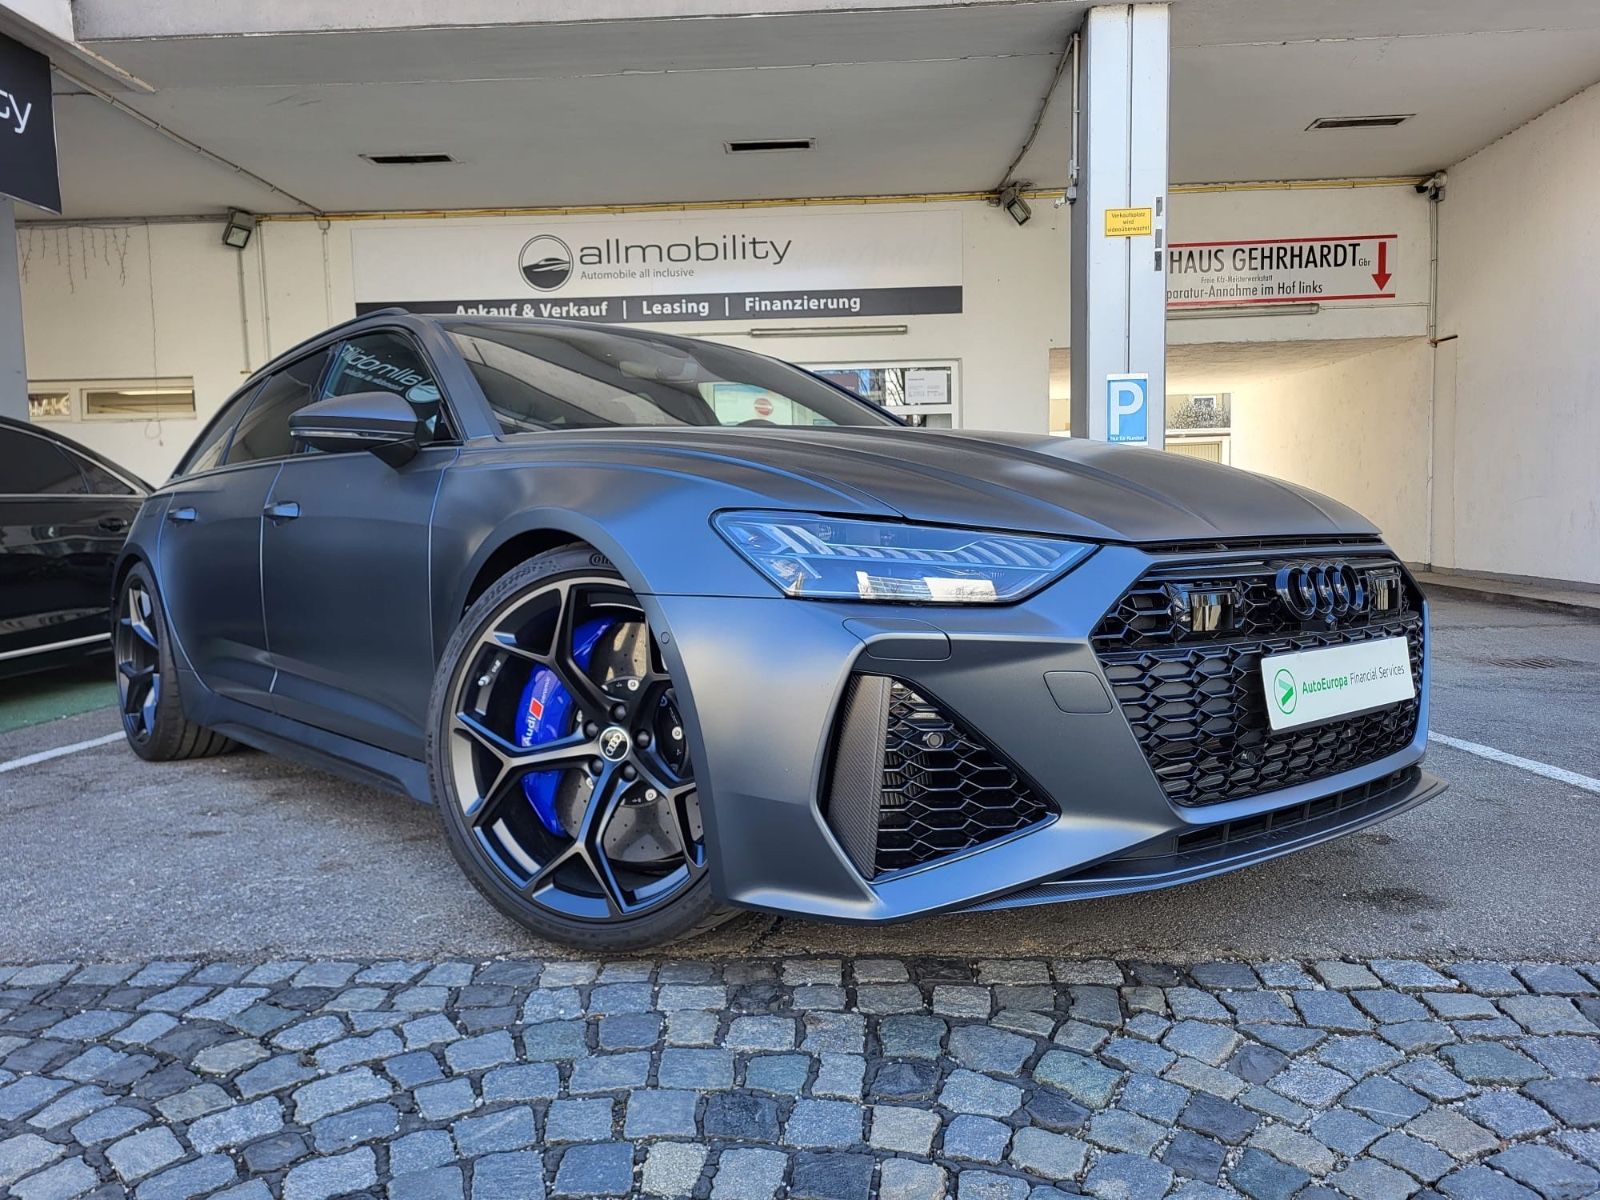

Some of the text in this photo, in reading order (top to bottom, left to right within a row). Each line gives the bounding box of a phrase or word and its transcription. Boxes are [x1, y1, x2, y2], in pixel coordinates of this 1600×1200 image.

[579, 234, 792, 265] allmobility
[1169, 243, 1371, 274] HAUS GEHRHARDT Gbr
[580, 267, 695, 281] Automobile all inclusive
[1261, 283, 1274, 296] im
[1277, 281, 1296, 296] Hof
[1298, 280, 1323, 294] links
[455, 295, 861, 317] Ankauf & Verkauf Leasing Finanzierung
[1110, 381, 1144, 435] P
[1302, 664, 1405, 694] AutoEuropa Financial Services
[521, 715, 537, 747] Audi
